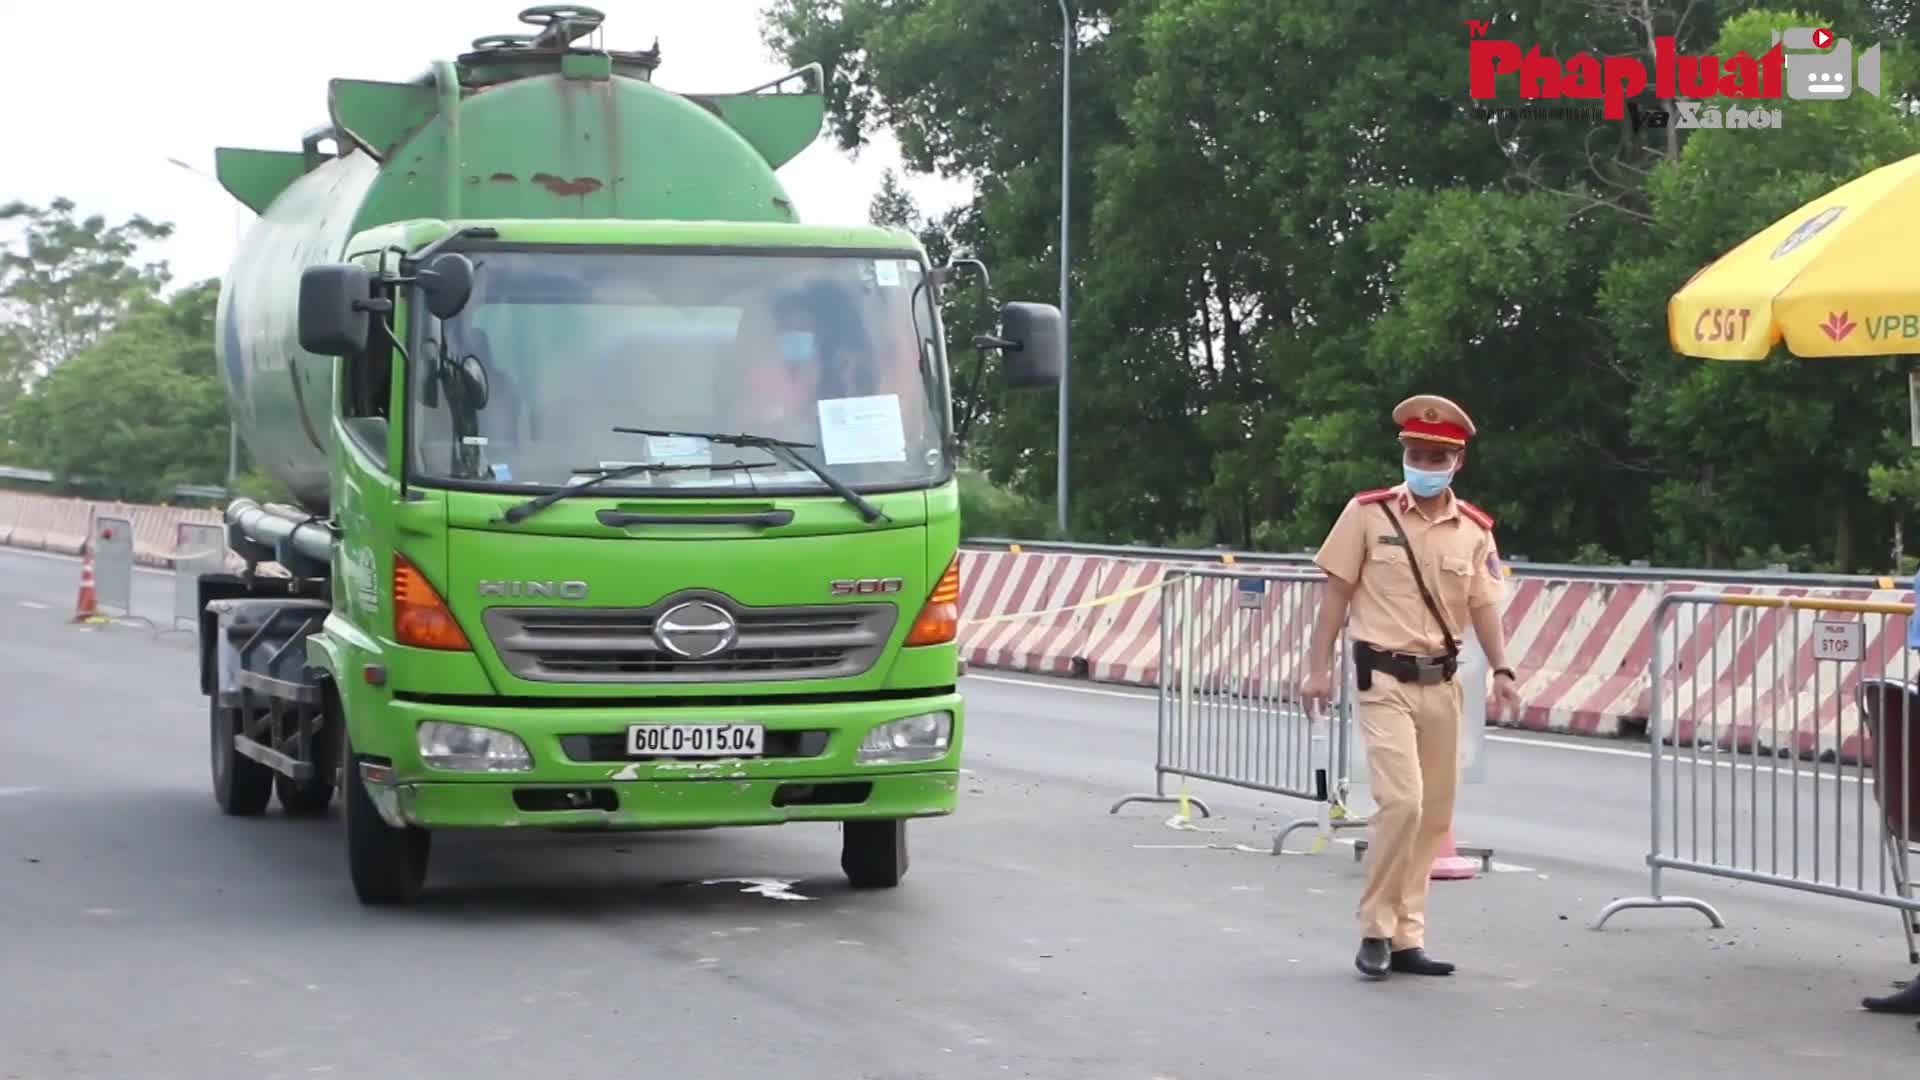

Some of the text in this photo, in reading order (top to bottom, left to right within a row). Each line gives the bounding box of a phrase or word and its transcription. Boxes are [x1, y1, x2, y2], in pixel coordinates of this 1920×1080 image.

[1694, 308, 1751, 341] CSGT
[1865, 315, 1920, 340] VPB
[478, 579, 587, 600] HINO
[830, 577, 903, 594] 500
[1822, 639, 1849, 652] STOP
[635, 727, 756, 750] 60LD-015.04
